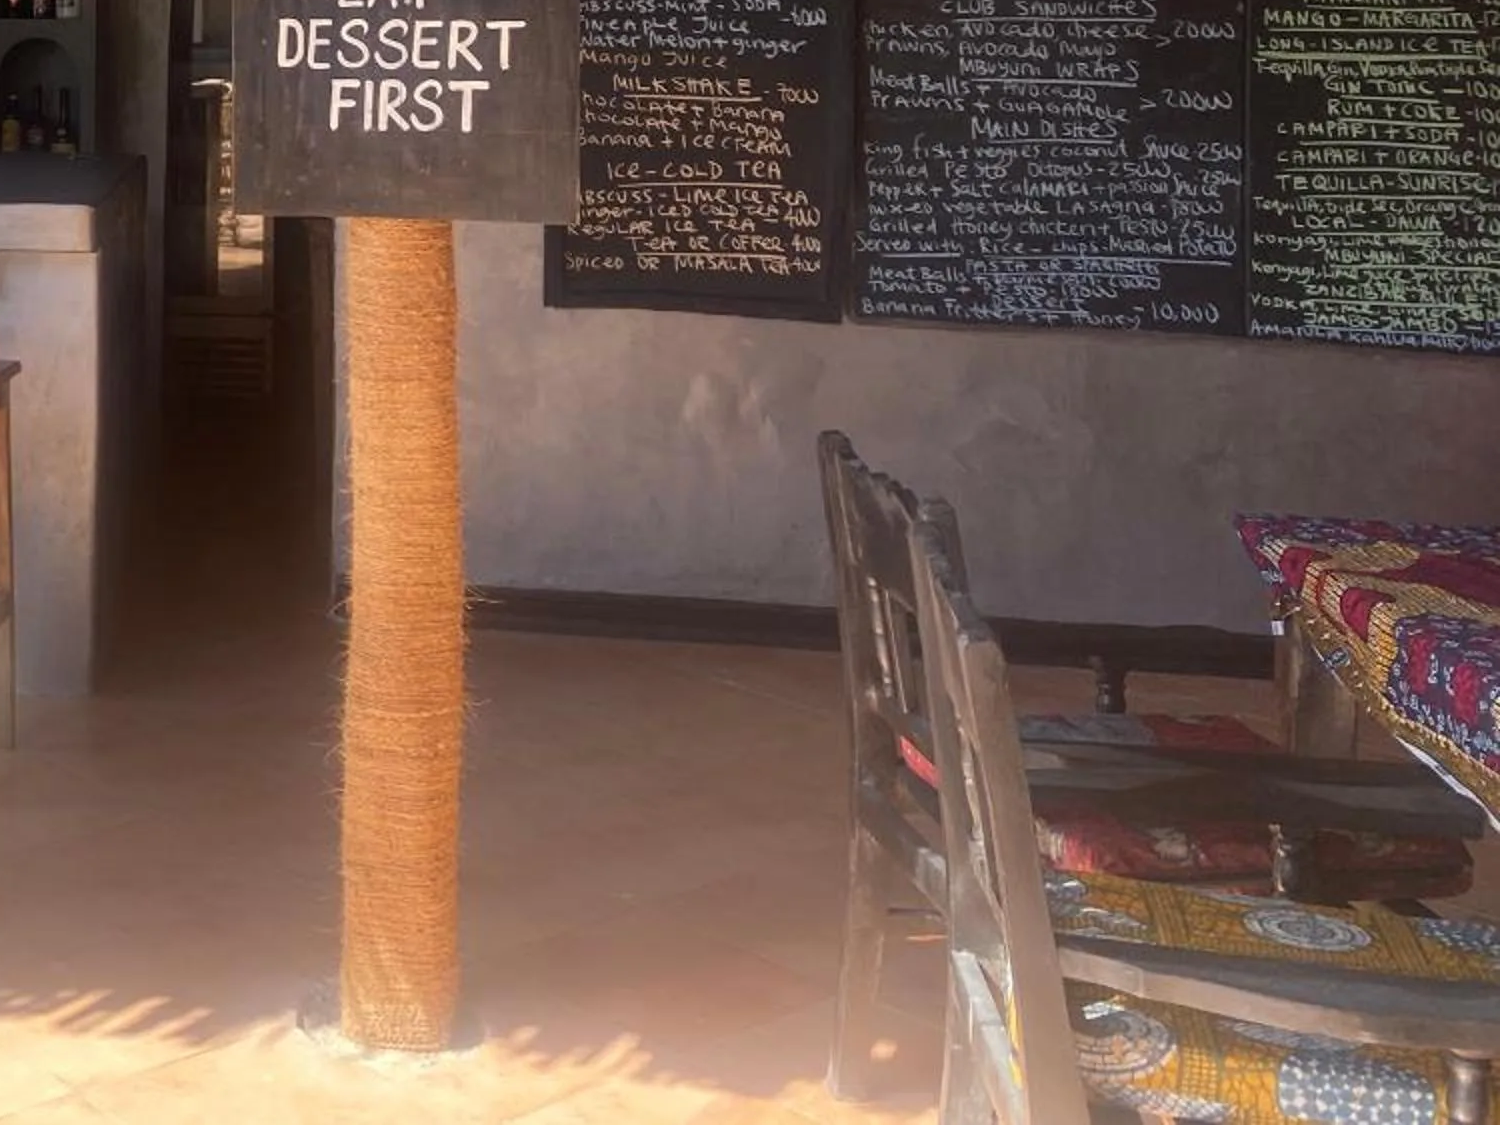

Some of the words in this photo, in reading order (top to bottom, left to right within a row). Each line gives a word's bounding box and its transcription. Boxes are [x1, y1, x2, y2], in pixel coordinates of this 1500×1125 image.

[277, 17, 527, 71] DESSERT
[1263, 8, 1342, 28] MANGO
[329, 78, 490, 134] FIRST
